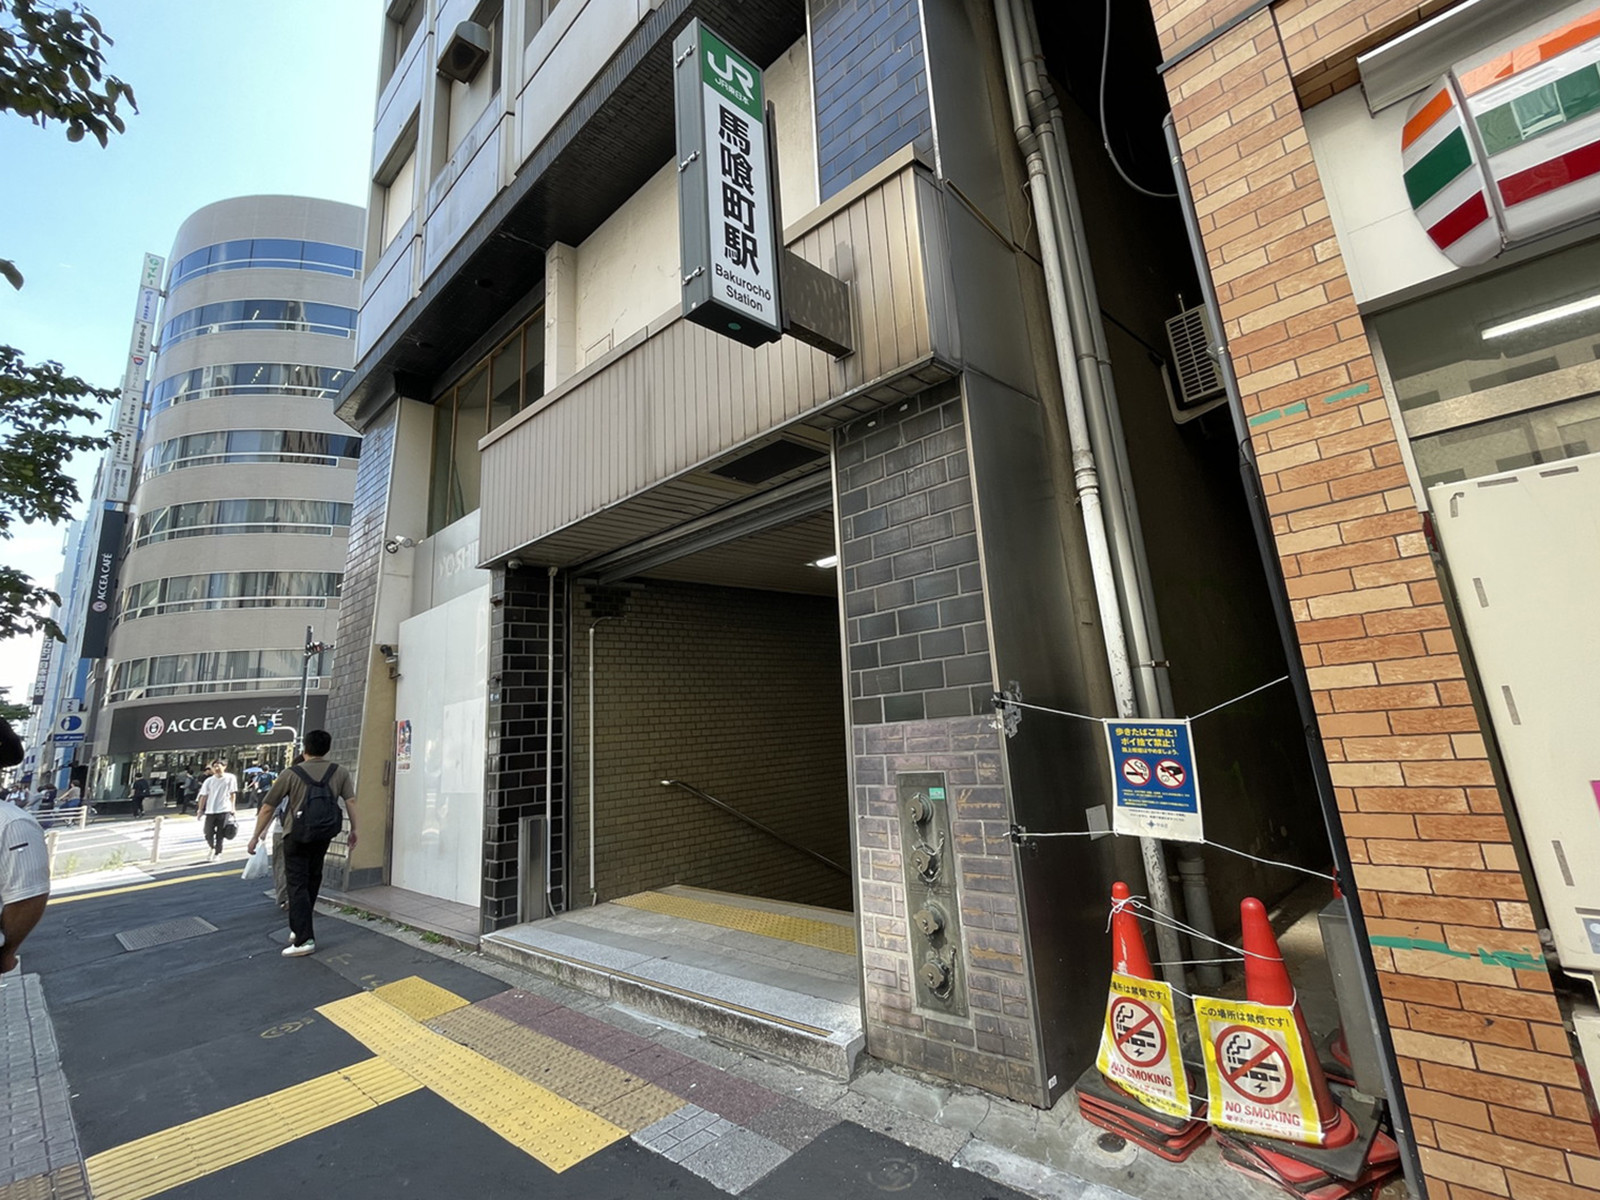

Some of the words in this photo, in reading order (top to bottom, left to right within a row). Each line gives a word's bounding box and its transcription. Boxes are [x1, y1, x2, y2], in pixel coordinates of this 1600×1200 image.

[707, 49, 755, 100] JR
[714, 76, 751, 106] JR東日本
[717, 103, 760, 277] 馬喰町駅
[725, 285, 763, 313] Station
[101, 552, 113, 575] CAFÉ
[96, 573, 109, 601] ACCEA
[166, 716, 227, 734] ACCEA
[232, 709, 283, 729] CAÉ
[1115, 728, 1178, 737] 歩きたばこ禁止！
[1121, 738, 1175, 747] ポイ捨て禁止！
[1199, 1006, 1291, 1028] この場所は禁煙です！
[1111, 1061, 1125, 1075] NO
[1126, 1067, 1172, 1087] SMOKING
[1224, 1100, 1242, 1114] NO
[1244, 1104, 1301, 1127] SMOKING
